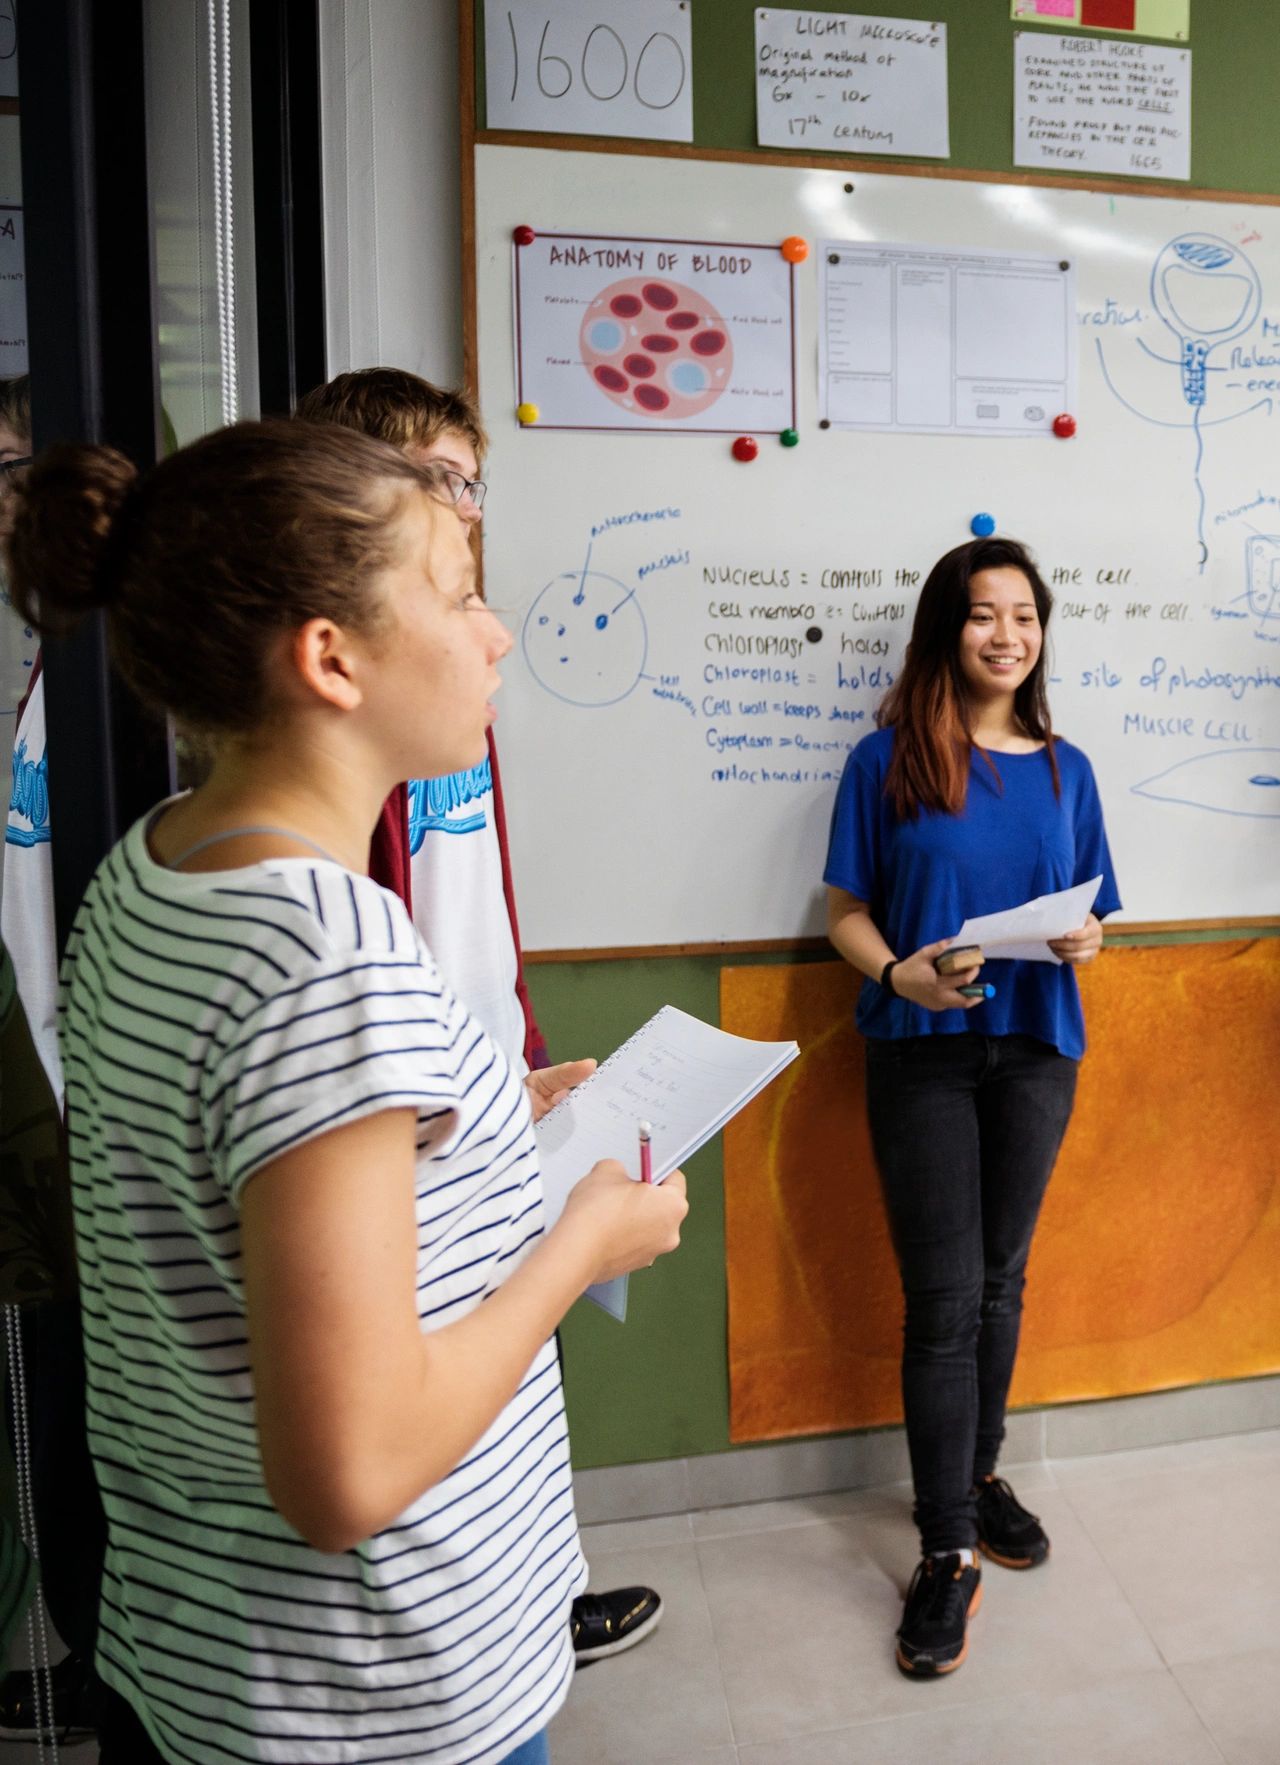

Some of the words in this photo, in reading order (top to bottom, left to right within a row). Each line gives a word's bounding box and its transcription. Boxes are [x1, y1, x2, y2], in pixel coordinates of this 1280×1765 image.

[796, 16, 848, 36] LIGHT
[507, 11, 685, 110] 1600
[549, 244, 645, 270] ANATOMY
[657, 252, 679, 271] OF
[692, 254, 752, 274] BLOOD
[838, 661, 894, 690] holds
